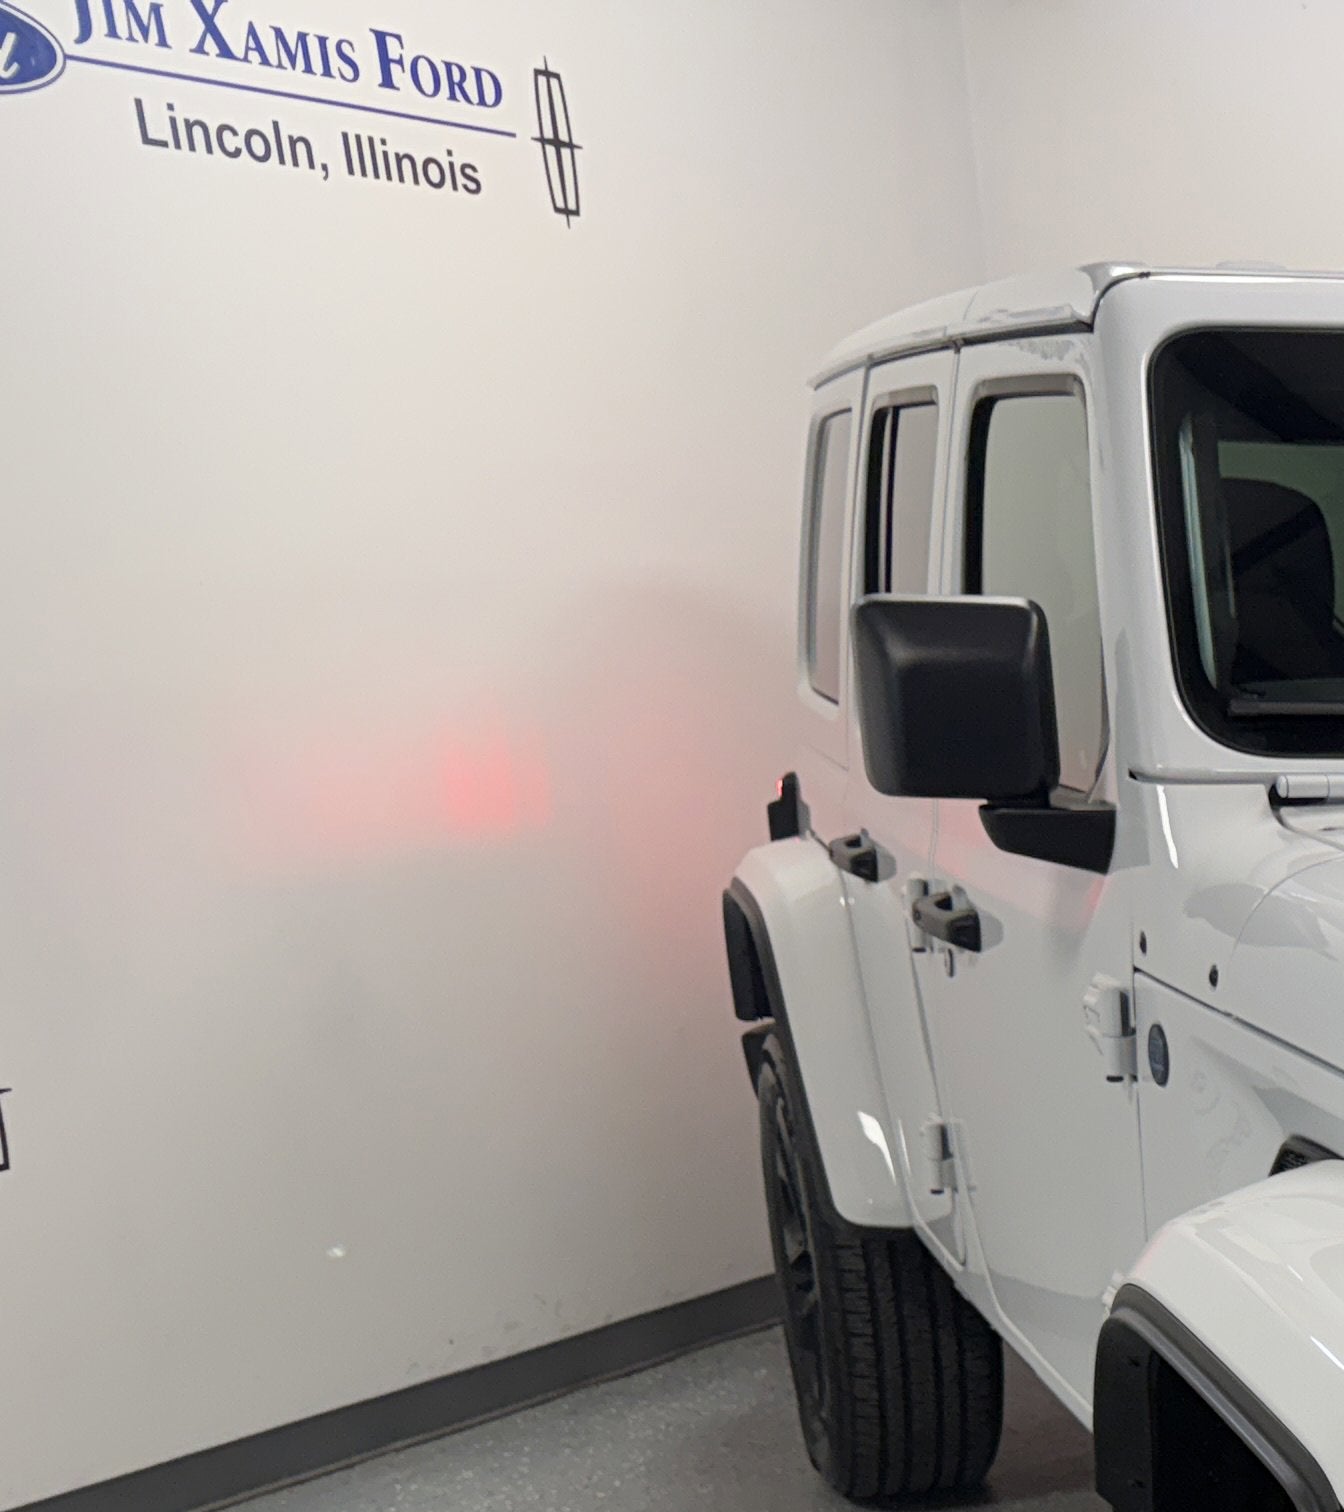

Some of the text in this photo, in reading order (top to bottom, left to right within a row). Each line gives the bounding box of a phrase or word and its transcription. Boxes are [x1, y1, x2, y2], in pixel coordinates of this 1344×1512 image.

[189, 0, 361, 83] XAMIS
[368, 27, 502, 108] FORD
[134, 98, 483, 195] Lincoln, Illinois
